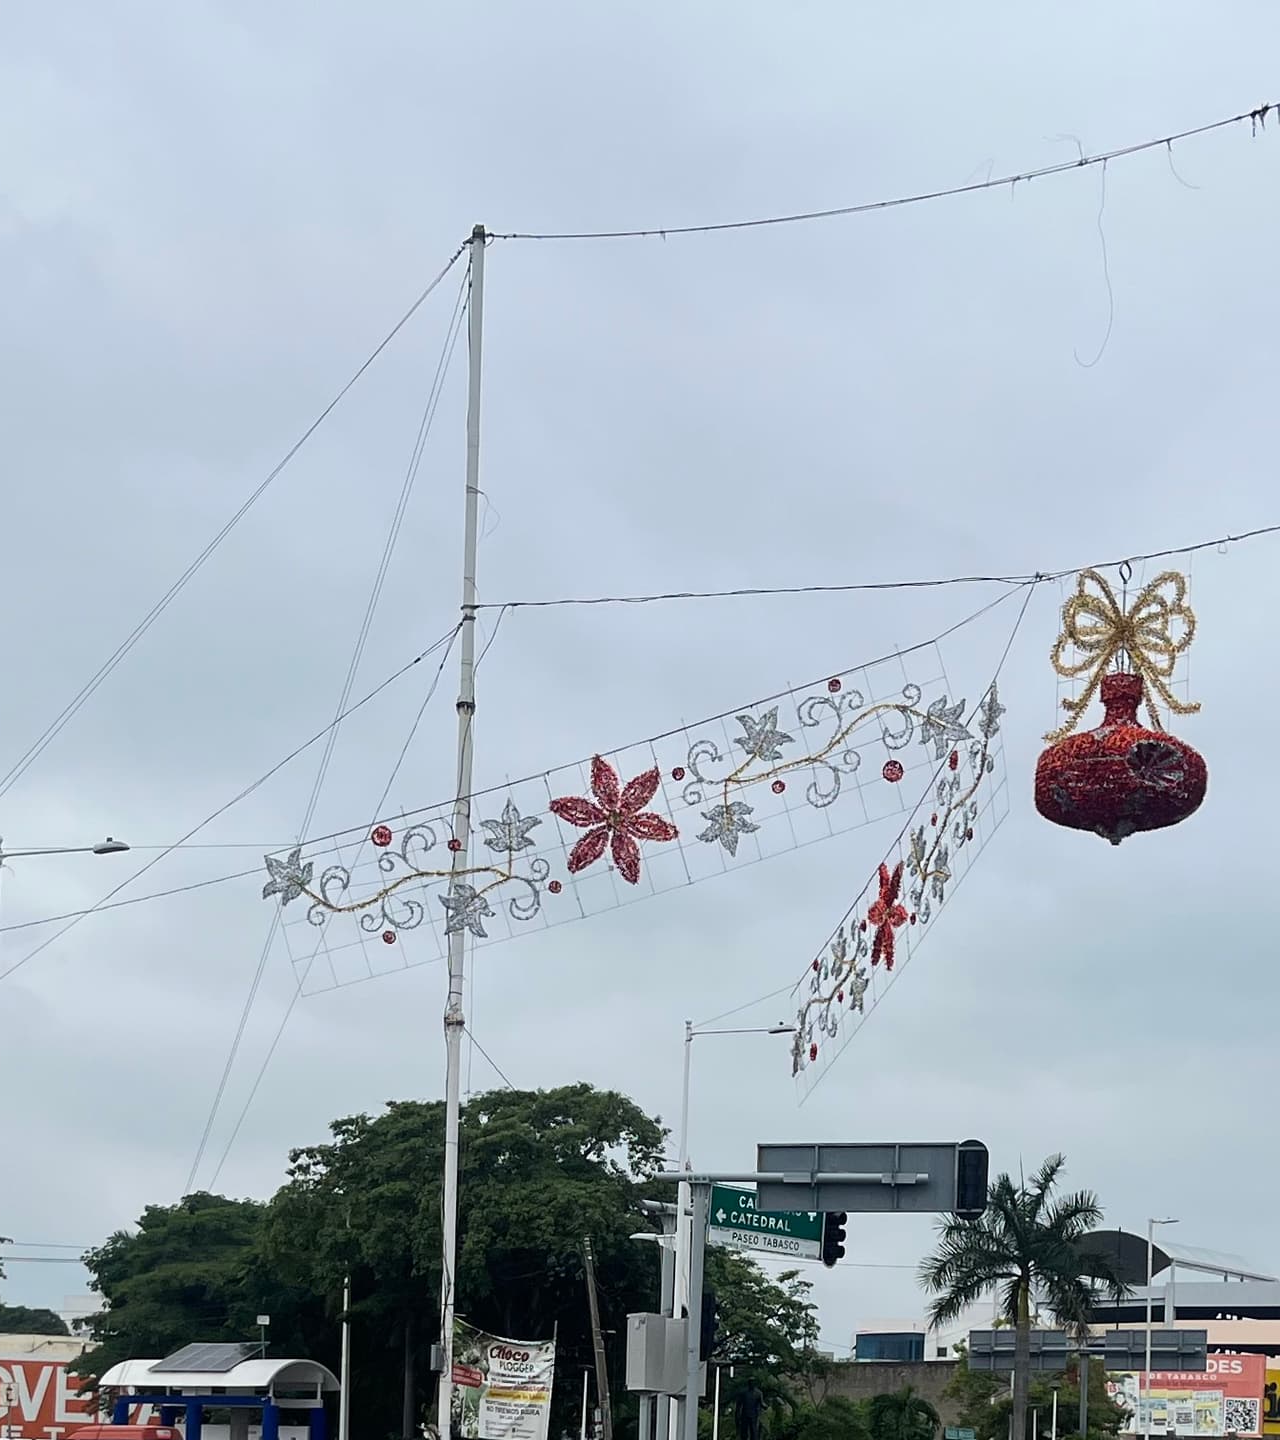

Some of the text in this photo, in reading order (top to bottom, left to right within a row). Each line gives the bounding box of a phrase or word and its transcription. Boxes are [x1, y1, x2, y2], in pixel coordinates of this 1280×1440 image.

[730, 1211, 792, 1232] CATEDRAL
[732, 1232, 800, 1251] PASEO TABASCO
[489, 1345, 530, 1362] Choco
[1168, 1373, 1217, 1381] TABASCO
